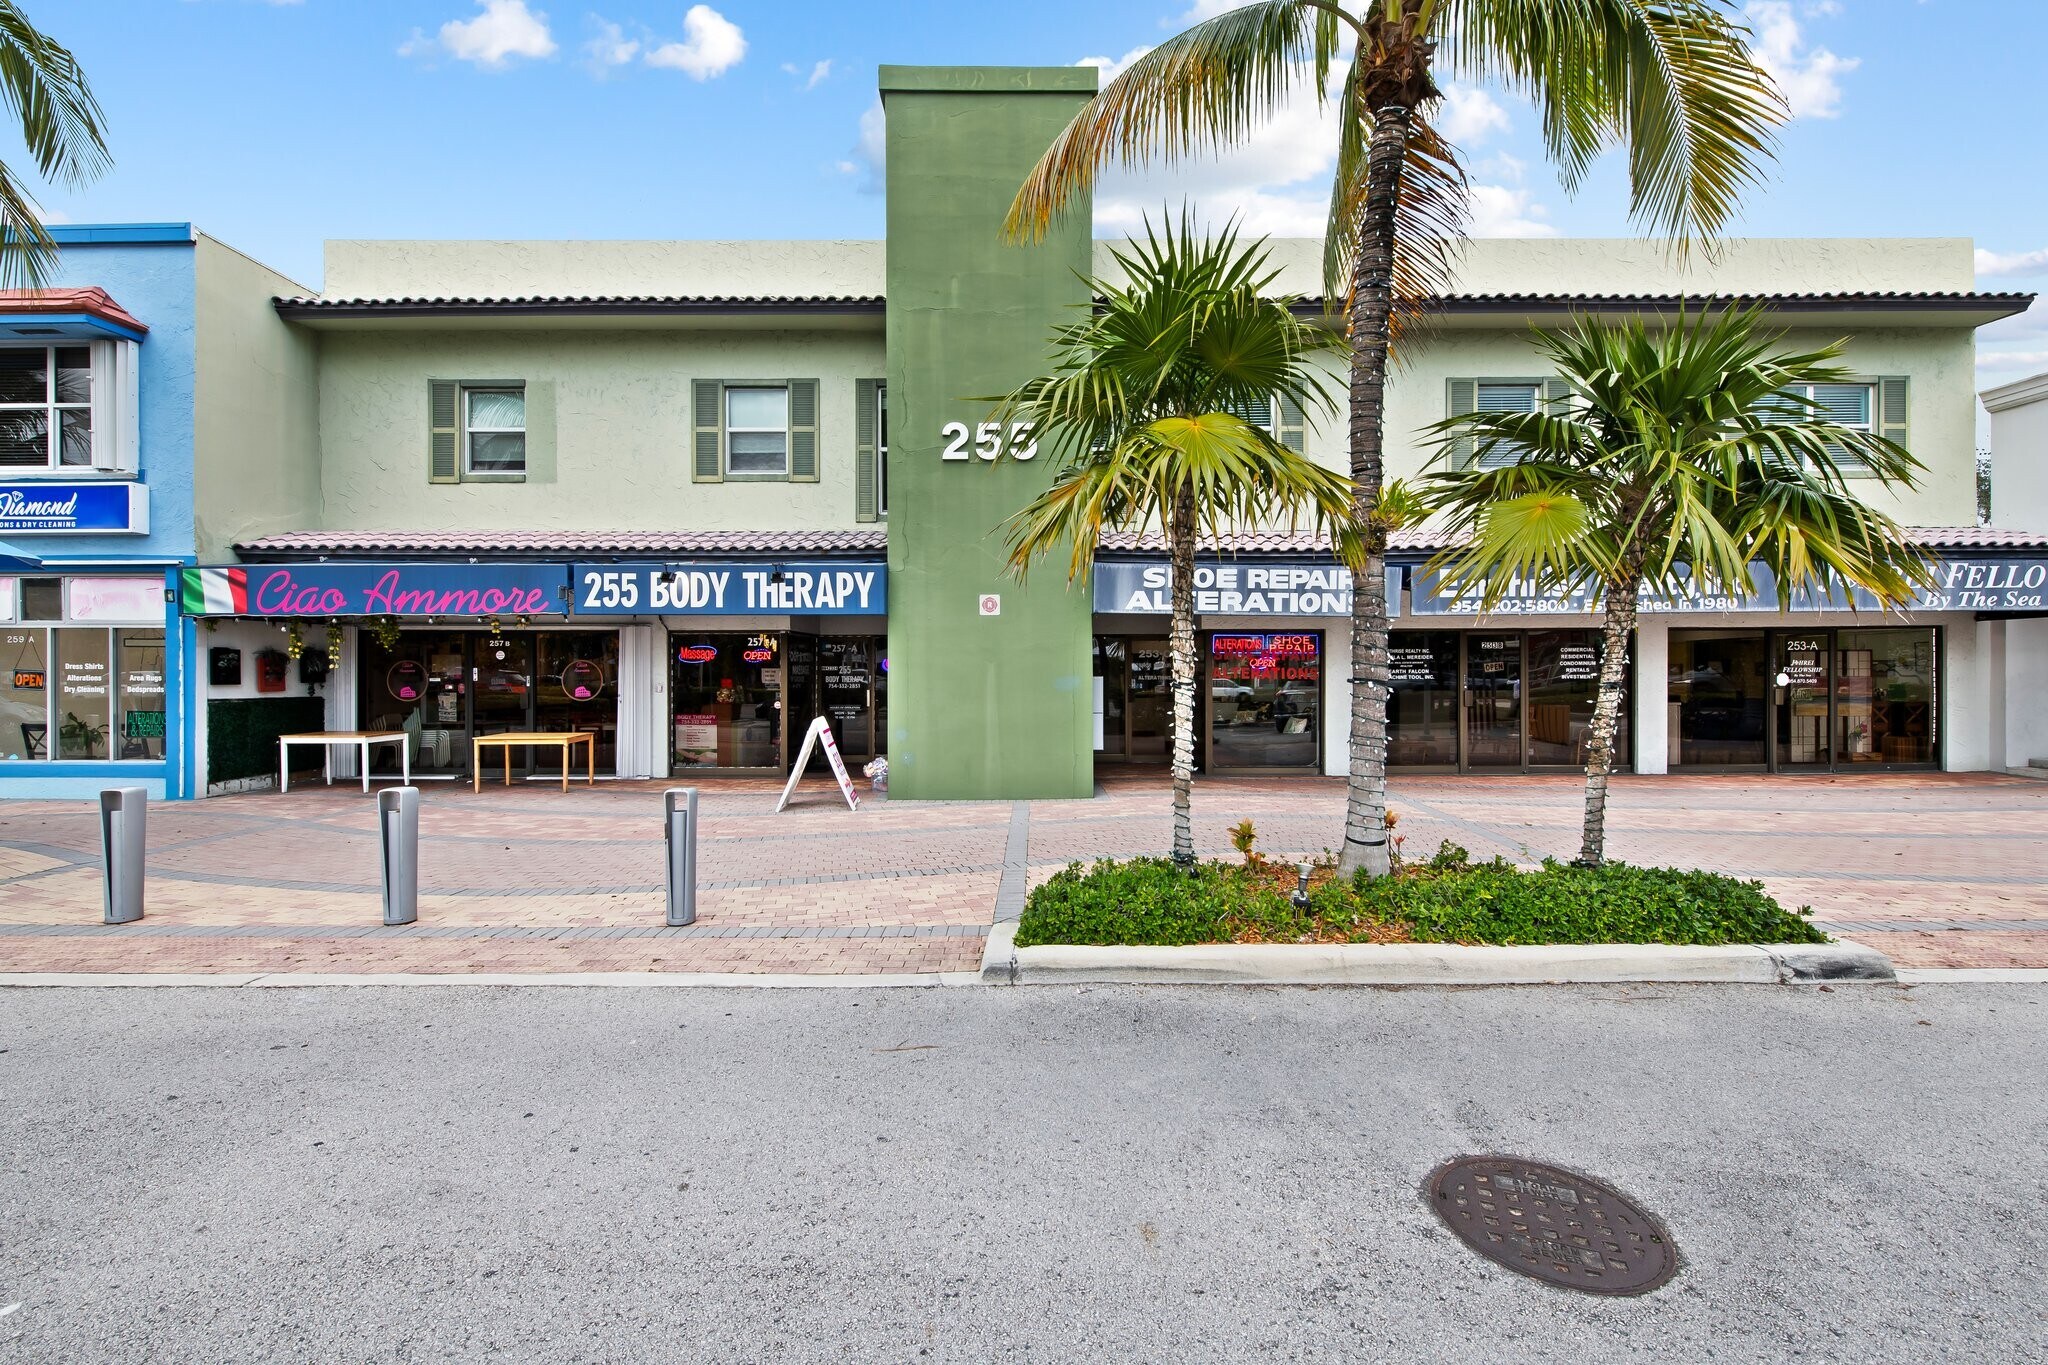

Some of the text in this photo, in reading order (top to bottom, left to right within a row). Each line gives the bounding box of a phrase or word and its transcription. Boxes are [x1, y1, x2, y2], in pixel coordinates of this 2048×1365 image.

[941, 421, 1038, 460] 255
[257, 570, 549, 613] Ciao Ammore
[584, 571, 874, 609] 255 BODY THERAPY
[1699, 597, 1738, 610] 1980
[1922, 591, 2041, 611] By The Sea
[1214, 638, 1262, 650] ALTERATIONS
[1274, 636, 1310, 645] SHOE
[1787, 640, 1818, 650] 253-A
[831, 644, 846, 653] 257
[1270, 644, 1315, 652] REPAIR
[680, 647, 716, 661] Massage
[743, 651, 771, 660] OPEN
[1249, 659, 1276, 668] OPEN
[1485, 663, 1503, 671] OPEN
[146, 675, 162, 683] Rugs
[1212, 667, 1318, 680] ALTERATIONS
[15, 673, 43, 687] OPEN
[64, 686, 105, 694] Dry Cleaning
[127, 686, 165, 694] Bedspreads
[139, 724, 164, 736] REPAIRS
